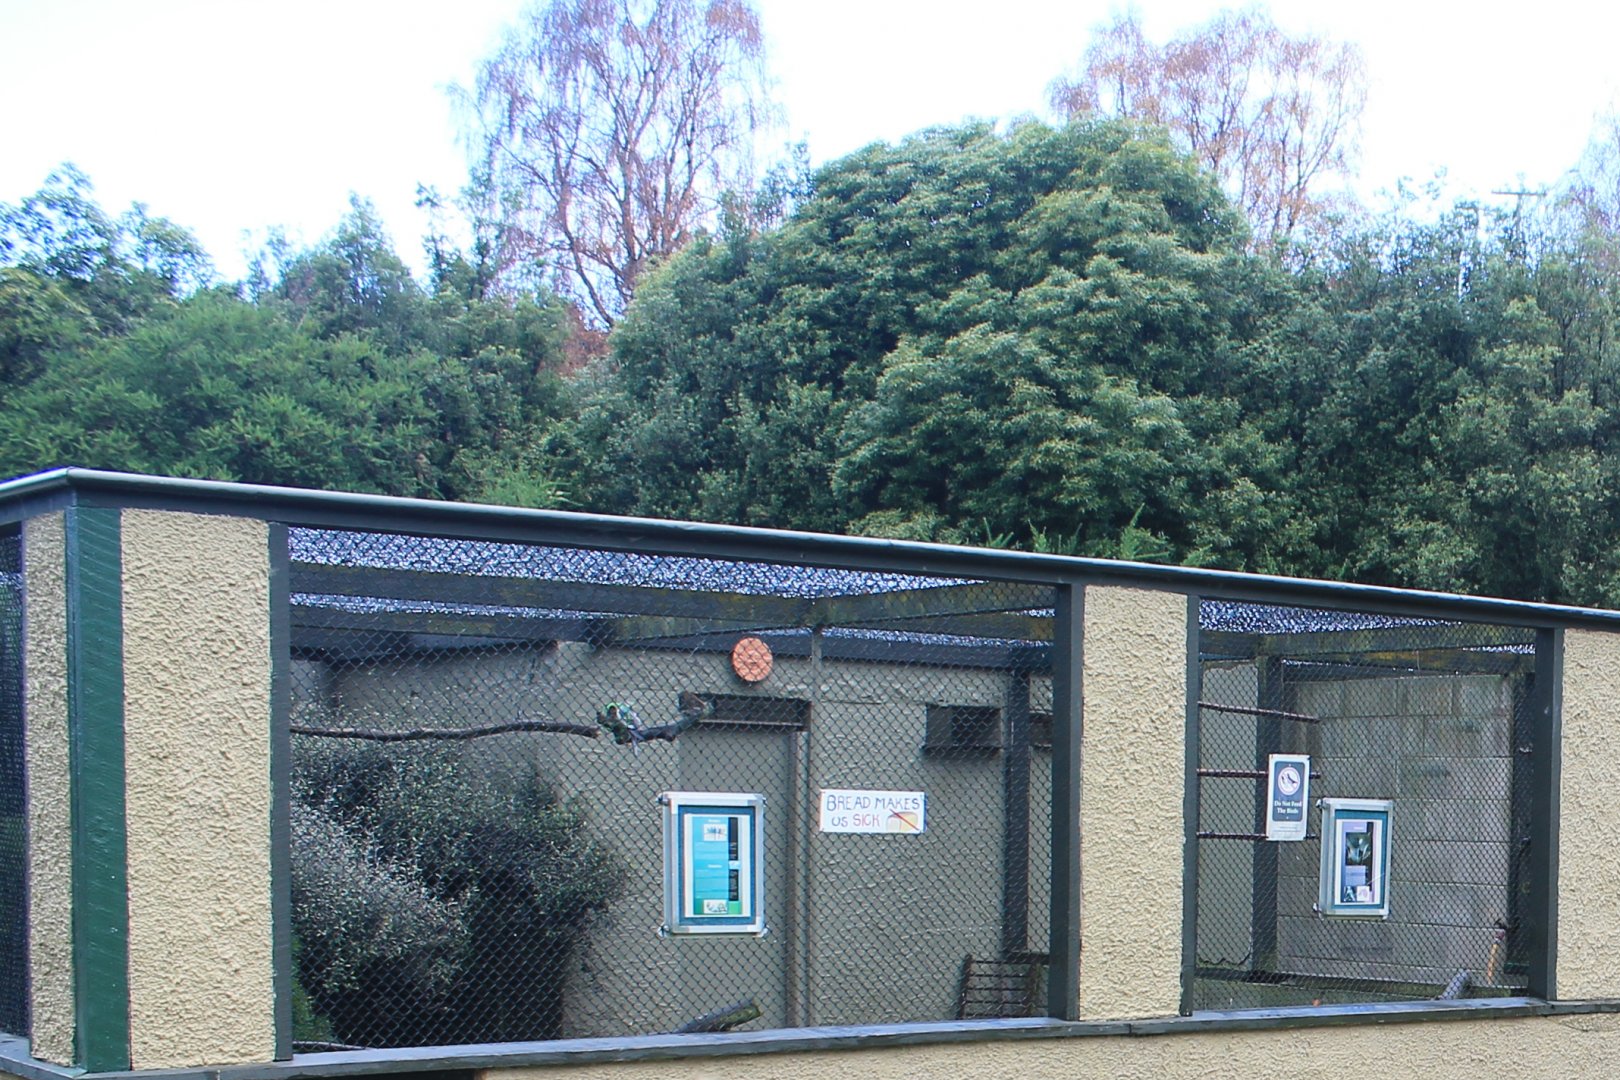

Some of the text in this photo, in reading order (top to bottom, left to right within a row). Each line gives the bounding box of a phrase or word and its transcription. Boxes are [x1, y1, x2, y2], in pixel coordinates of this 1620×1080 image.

[826, 794, 920, 811] BREAD MAKES
[831, 813, 880, 827] US SICK
